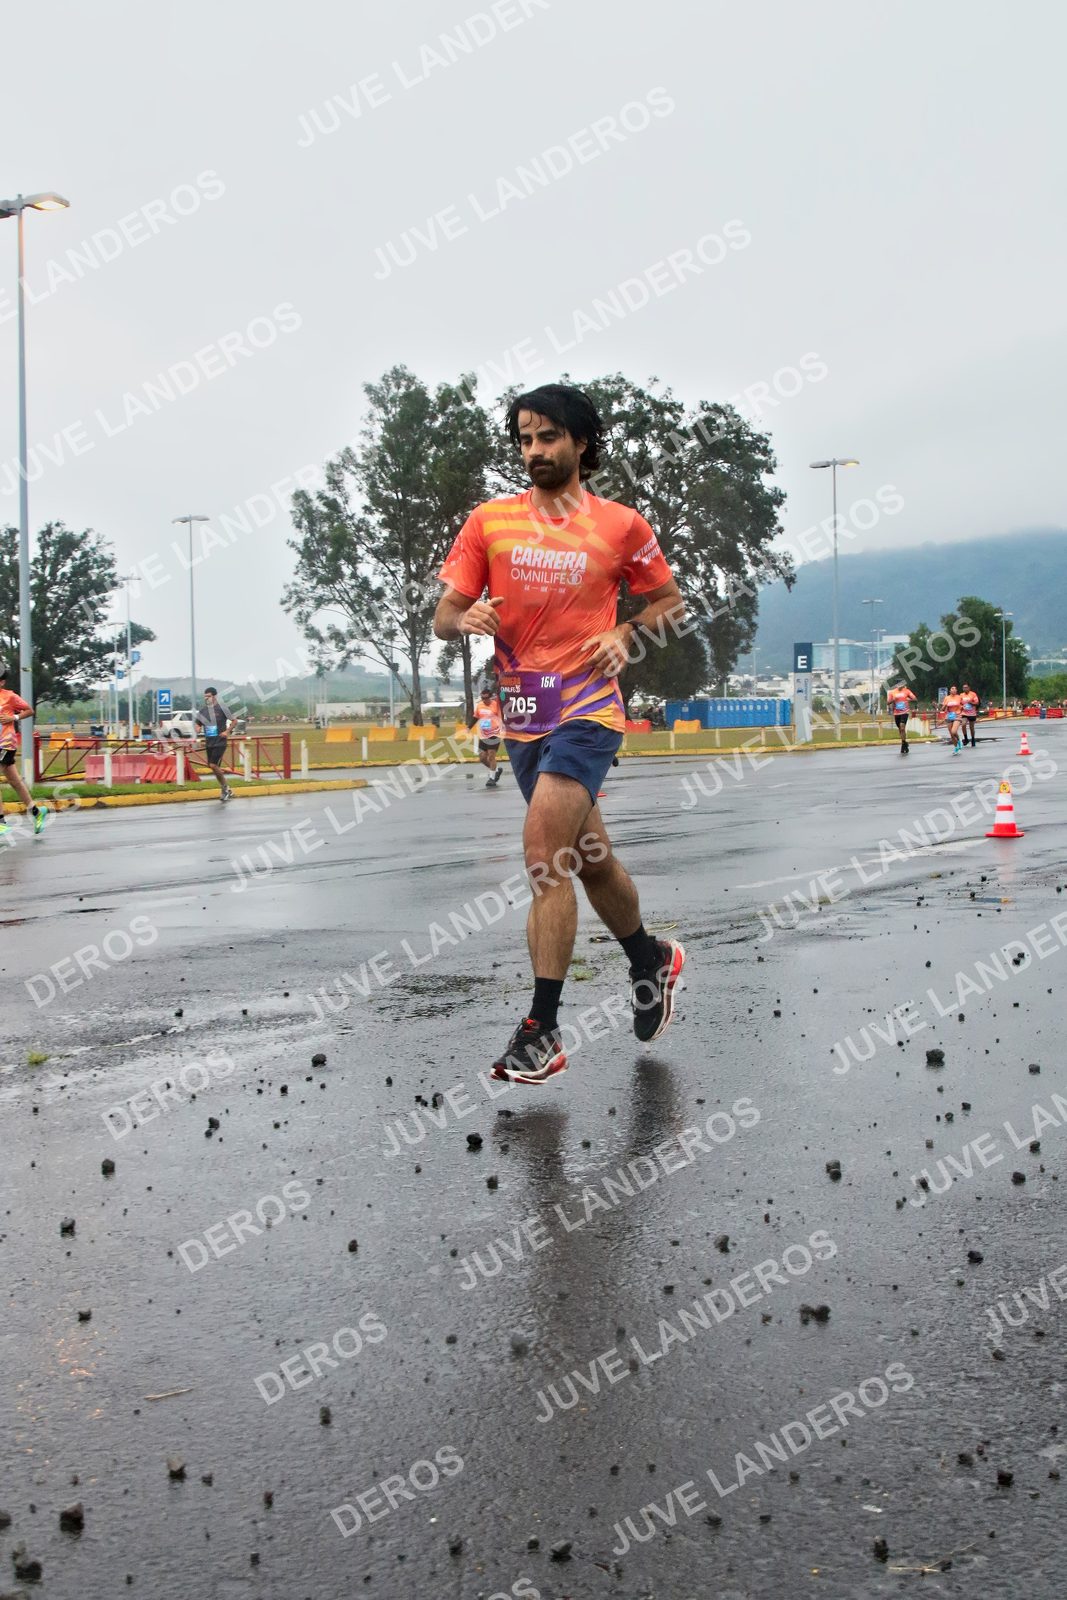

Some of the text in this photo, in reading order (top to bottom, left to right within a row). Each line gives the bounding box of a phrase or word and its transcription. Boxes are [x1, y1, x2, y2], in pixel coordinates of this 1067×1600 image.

[511, 545, 588, 570] CARRERA
[511, 568, 566, 586] OMNILIFE
[797, 655, 808, 669] E
[509, 696, 537, 714] 705
